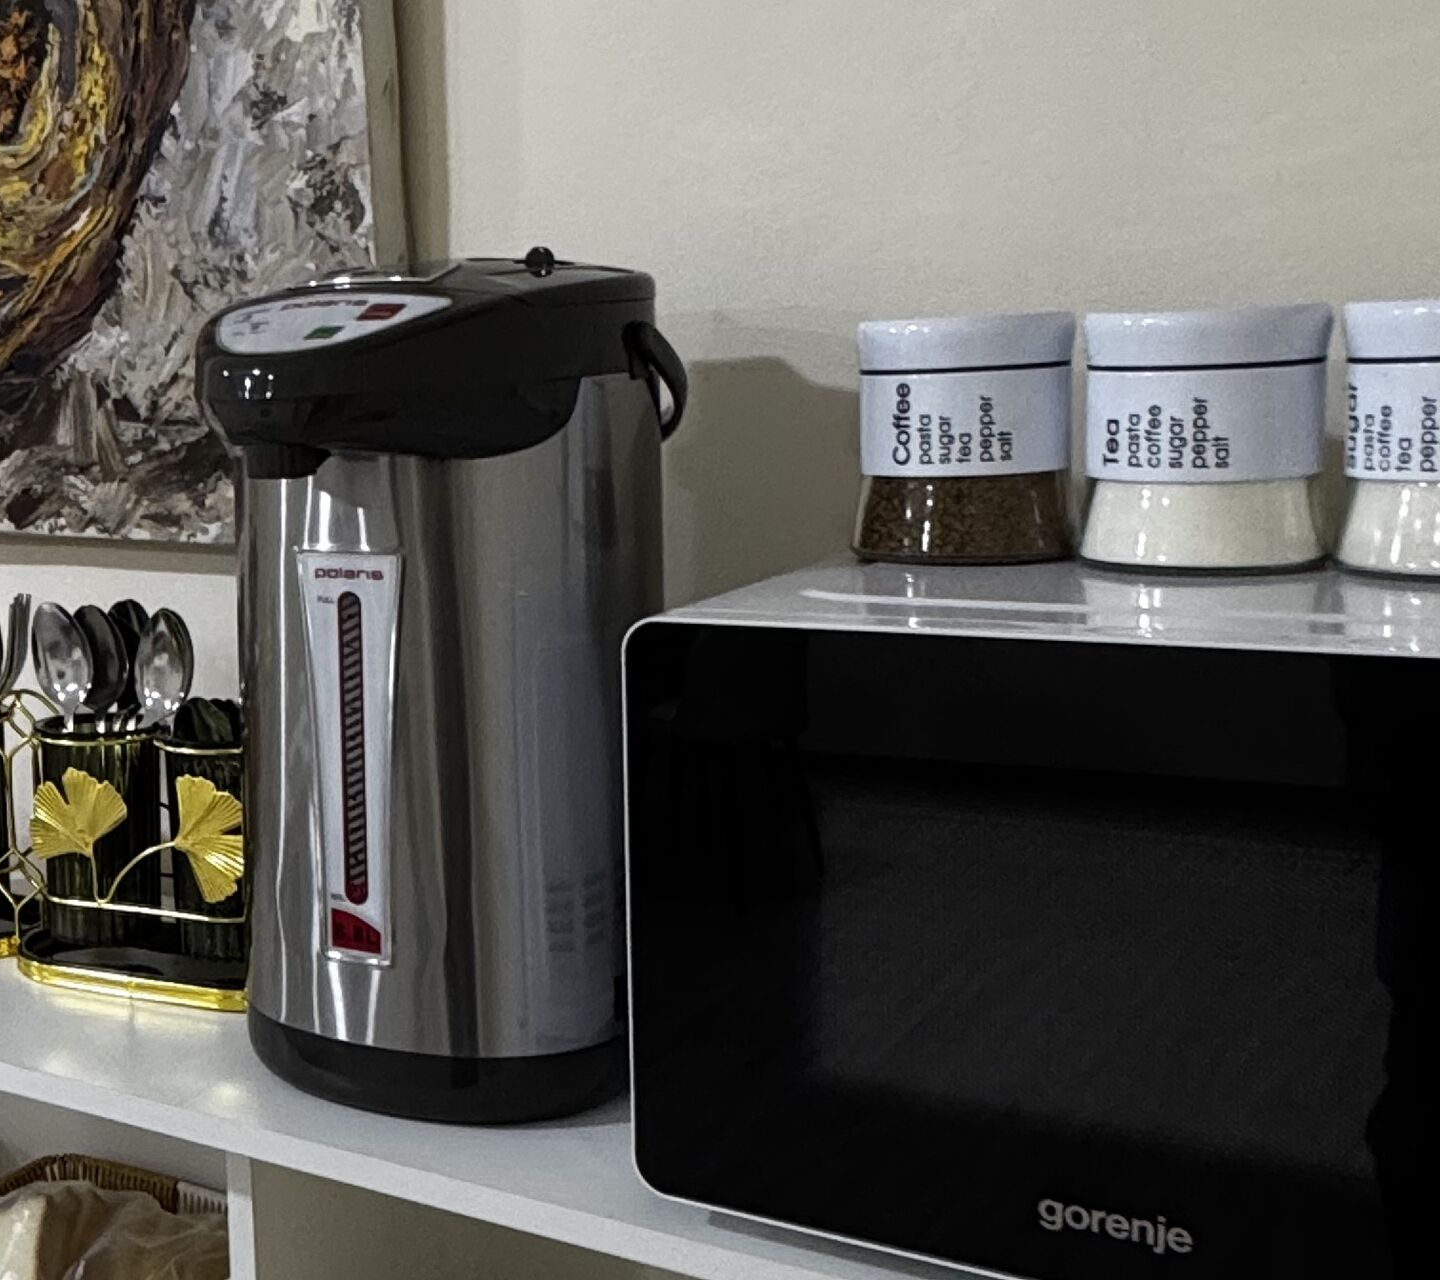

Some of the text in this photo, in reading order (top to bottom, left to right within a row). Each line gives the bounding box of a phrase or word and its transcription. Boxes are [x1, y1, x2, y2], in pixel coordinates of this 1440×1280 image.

[892, 382, 911, 466] Coffee
[917, 414, 934, 465] pasta
[939, 416, 955, 465] sugar
[955, 432, 972, 464] tea
[980, 395, 996, 463] pepper
[997, 431, 1013, 462] salt
[1103, 419, 1120, 466] Tea
[1126, 413, 1144, 468] pasta
[1144, 404, 1162, 469] coffee
[1168, 415, 1188, 469] sugar
[1192, 397, 1210, 469] pepper
[1363, 414, 1376, 471] pasta
[1377, 405, 1393, 472] coffee
[1420, 396, 1440, 473] pepper
[1211, 435, 1230, 469] salt
[1395, 437, 1412, 472] tea
[314, 568, 385, 581] polaris
[1037, 1198, 1194, 1254] gorenje
